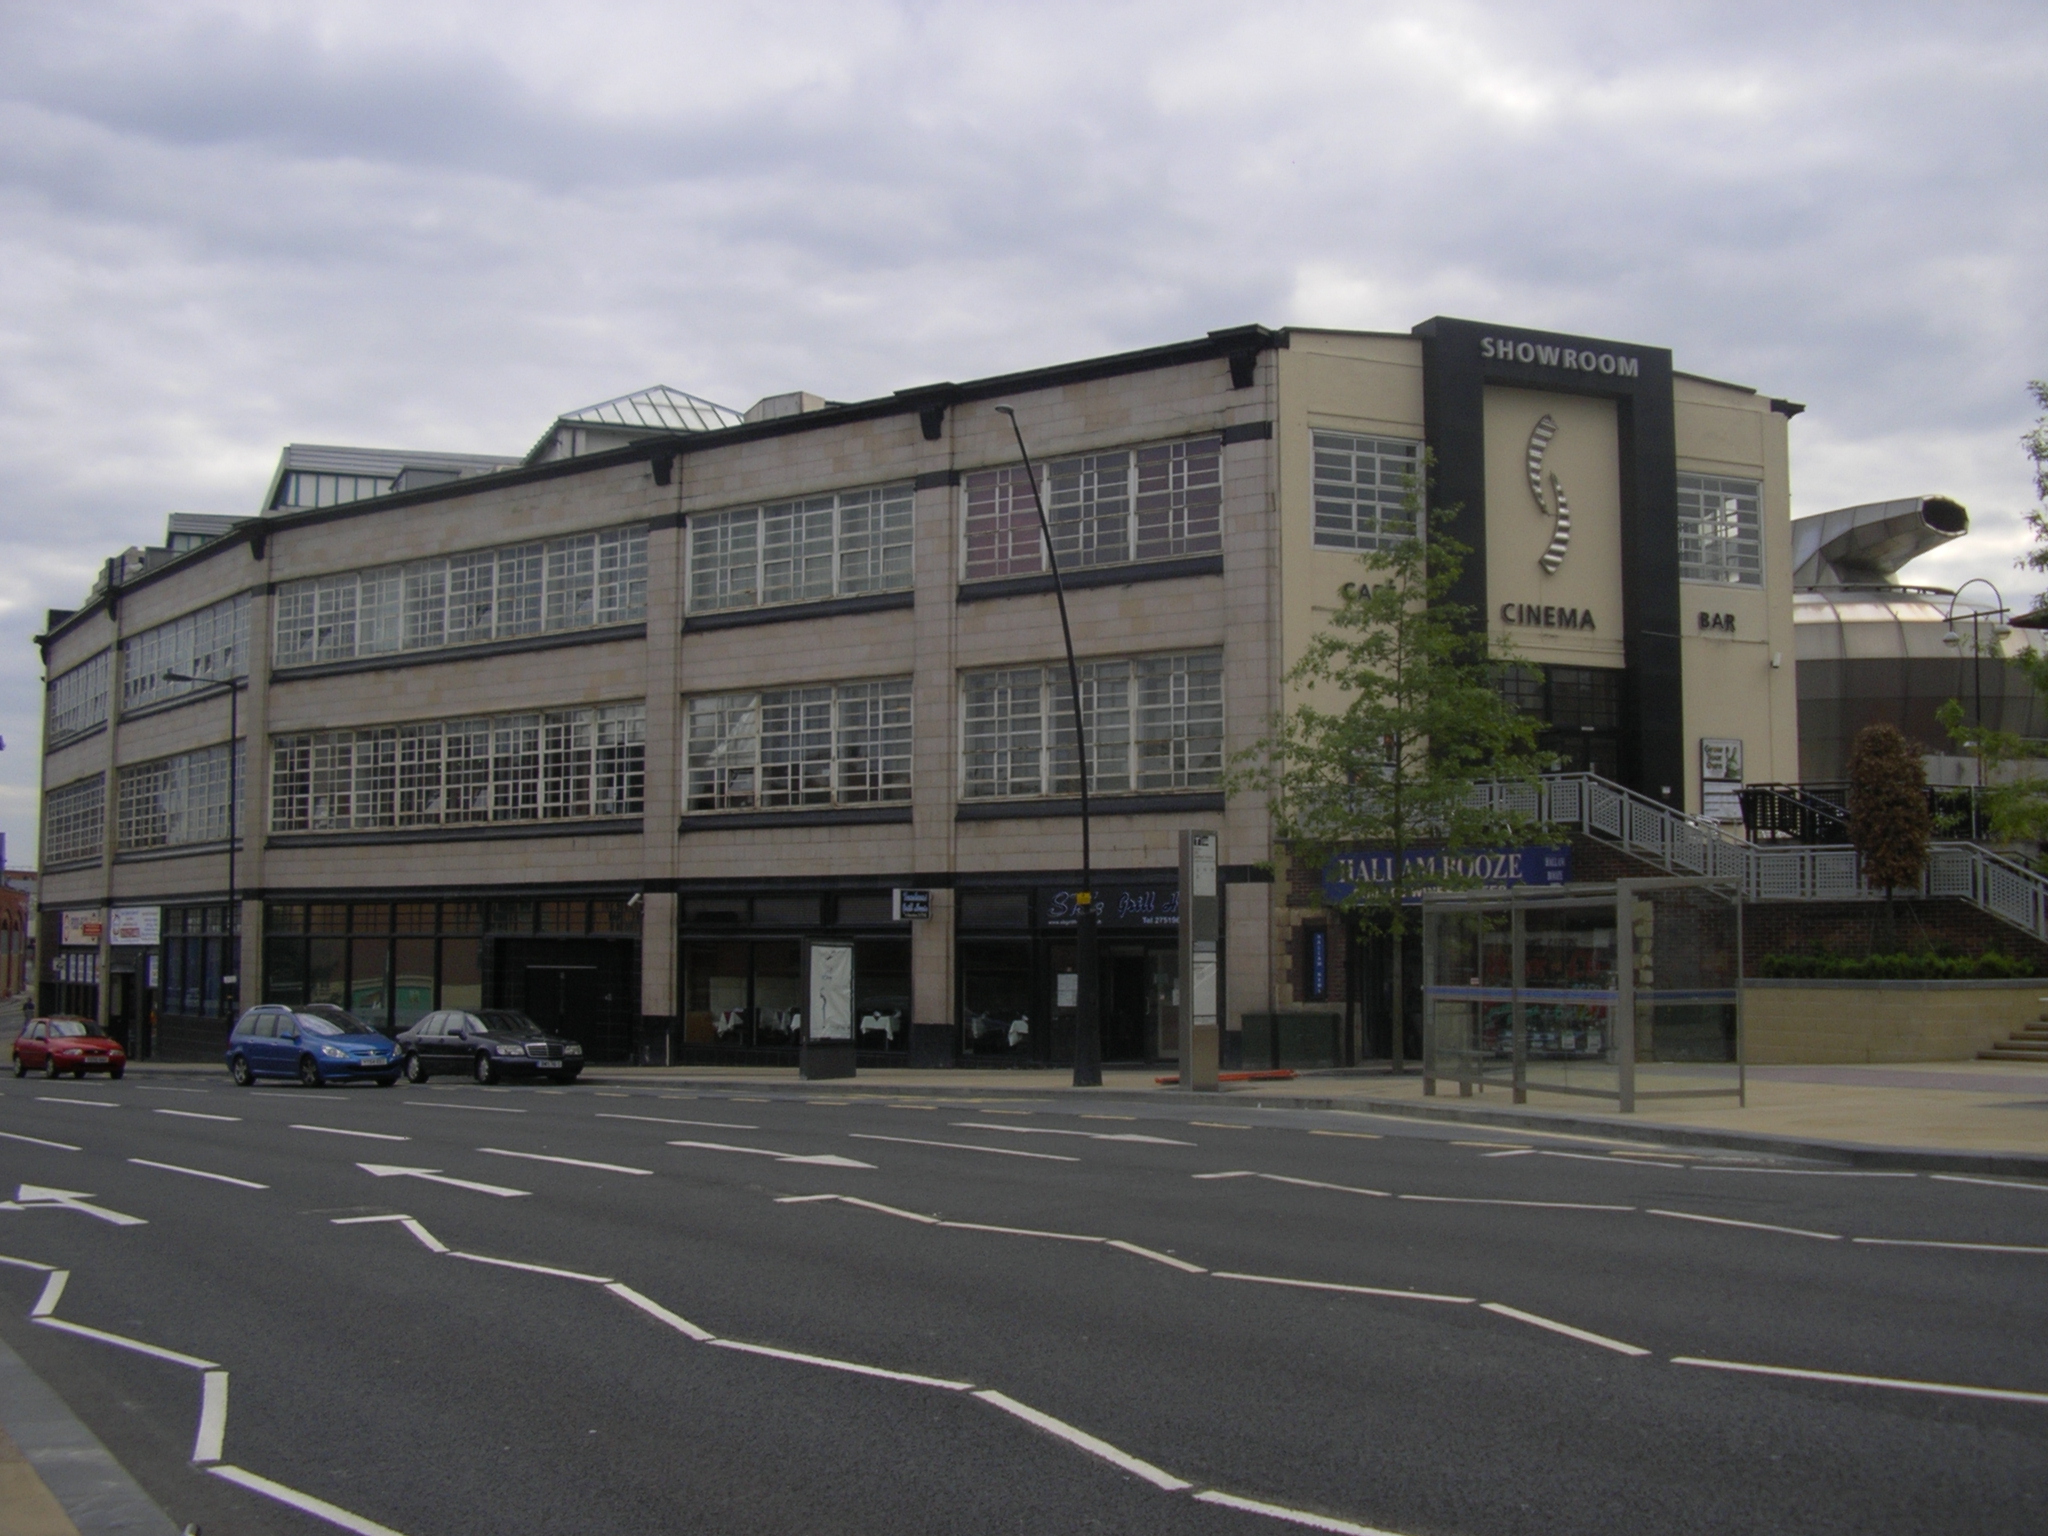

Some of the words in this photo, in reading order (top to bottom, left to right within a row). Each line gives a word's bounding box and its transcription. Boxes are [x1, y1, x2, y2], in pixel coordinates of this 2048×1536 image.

[1480, 336, 1639, 378] SHOWROOM
[1500, 603, 1596, 632] CINEMA
[1698, 611, 1736, 633] BAR
